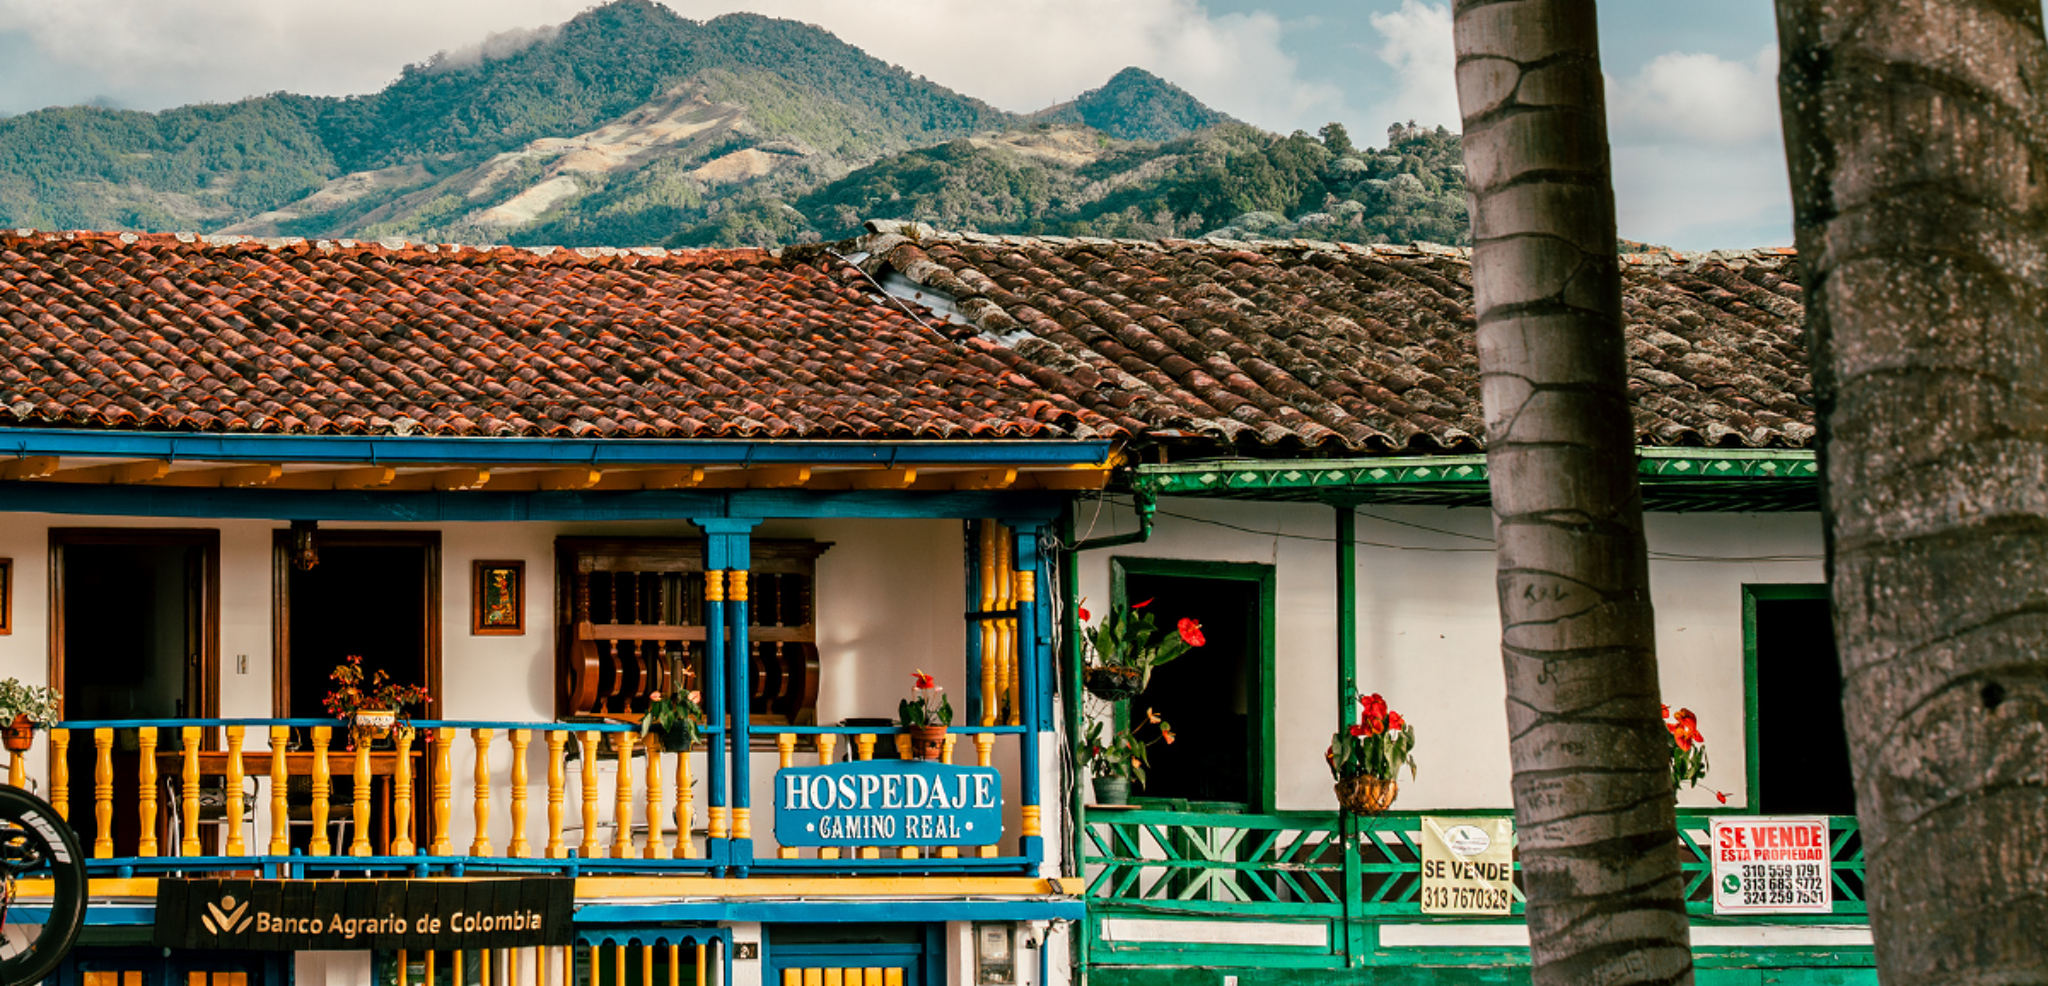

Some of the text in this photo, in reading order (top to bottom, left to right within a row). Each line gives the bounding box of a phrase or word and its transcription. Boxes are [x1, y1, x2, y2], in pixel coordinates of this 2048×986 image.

[783, 773, 995, 810] HOSPEDAJE
[819, 815, 961, 838] CAMINO REAL
[1719, 827, 1822, 848] SE VENDE
[1721, 848, 1822, 862] ESTA PROPIEDAD
[1424, 860, 1510, 881] SE VENDE
[1742, 864, 1766, 878] 310
[1768, 864, 1793, 878] 559
[1743, 878, 1766, 891] 313
[1424, 886, 1508, 909] 313 7670328
[1743, 891, 1767, 905] 324
[1769, 891, 1794, 904] 259
[257, 909, 542, 939] Banco Agrario de Colombia
